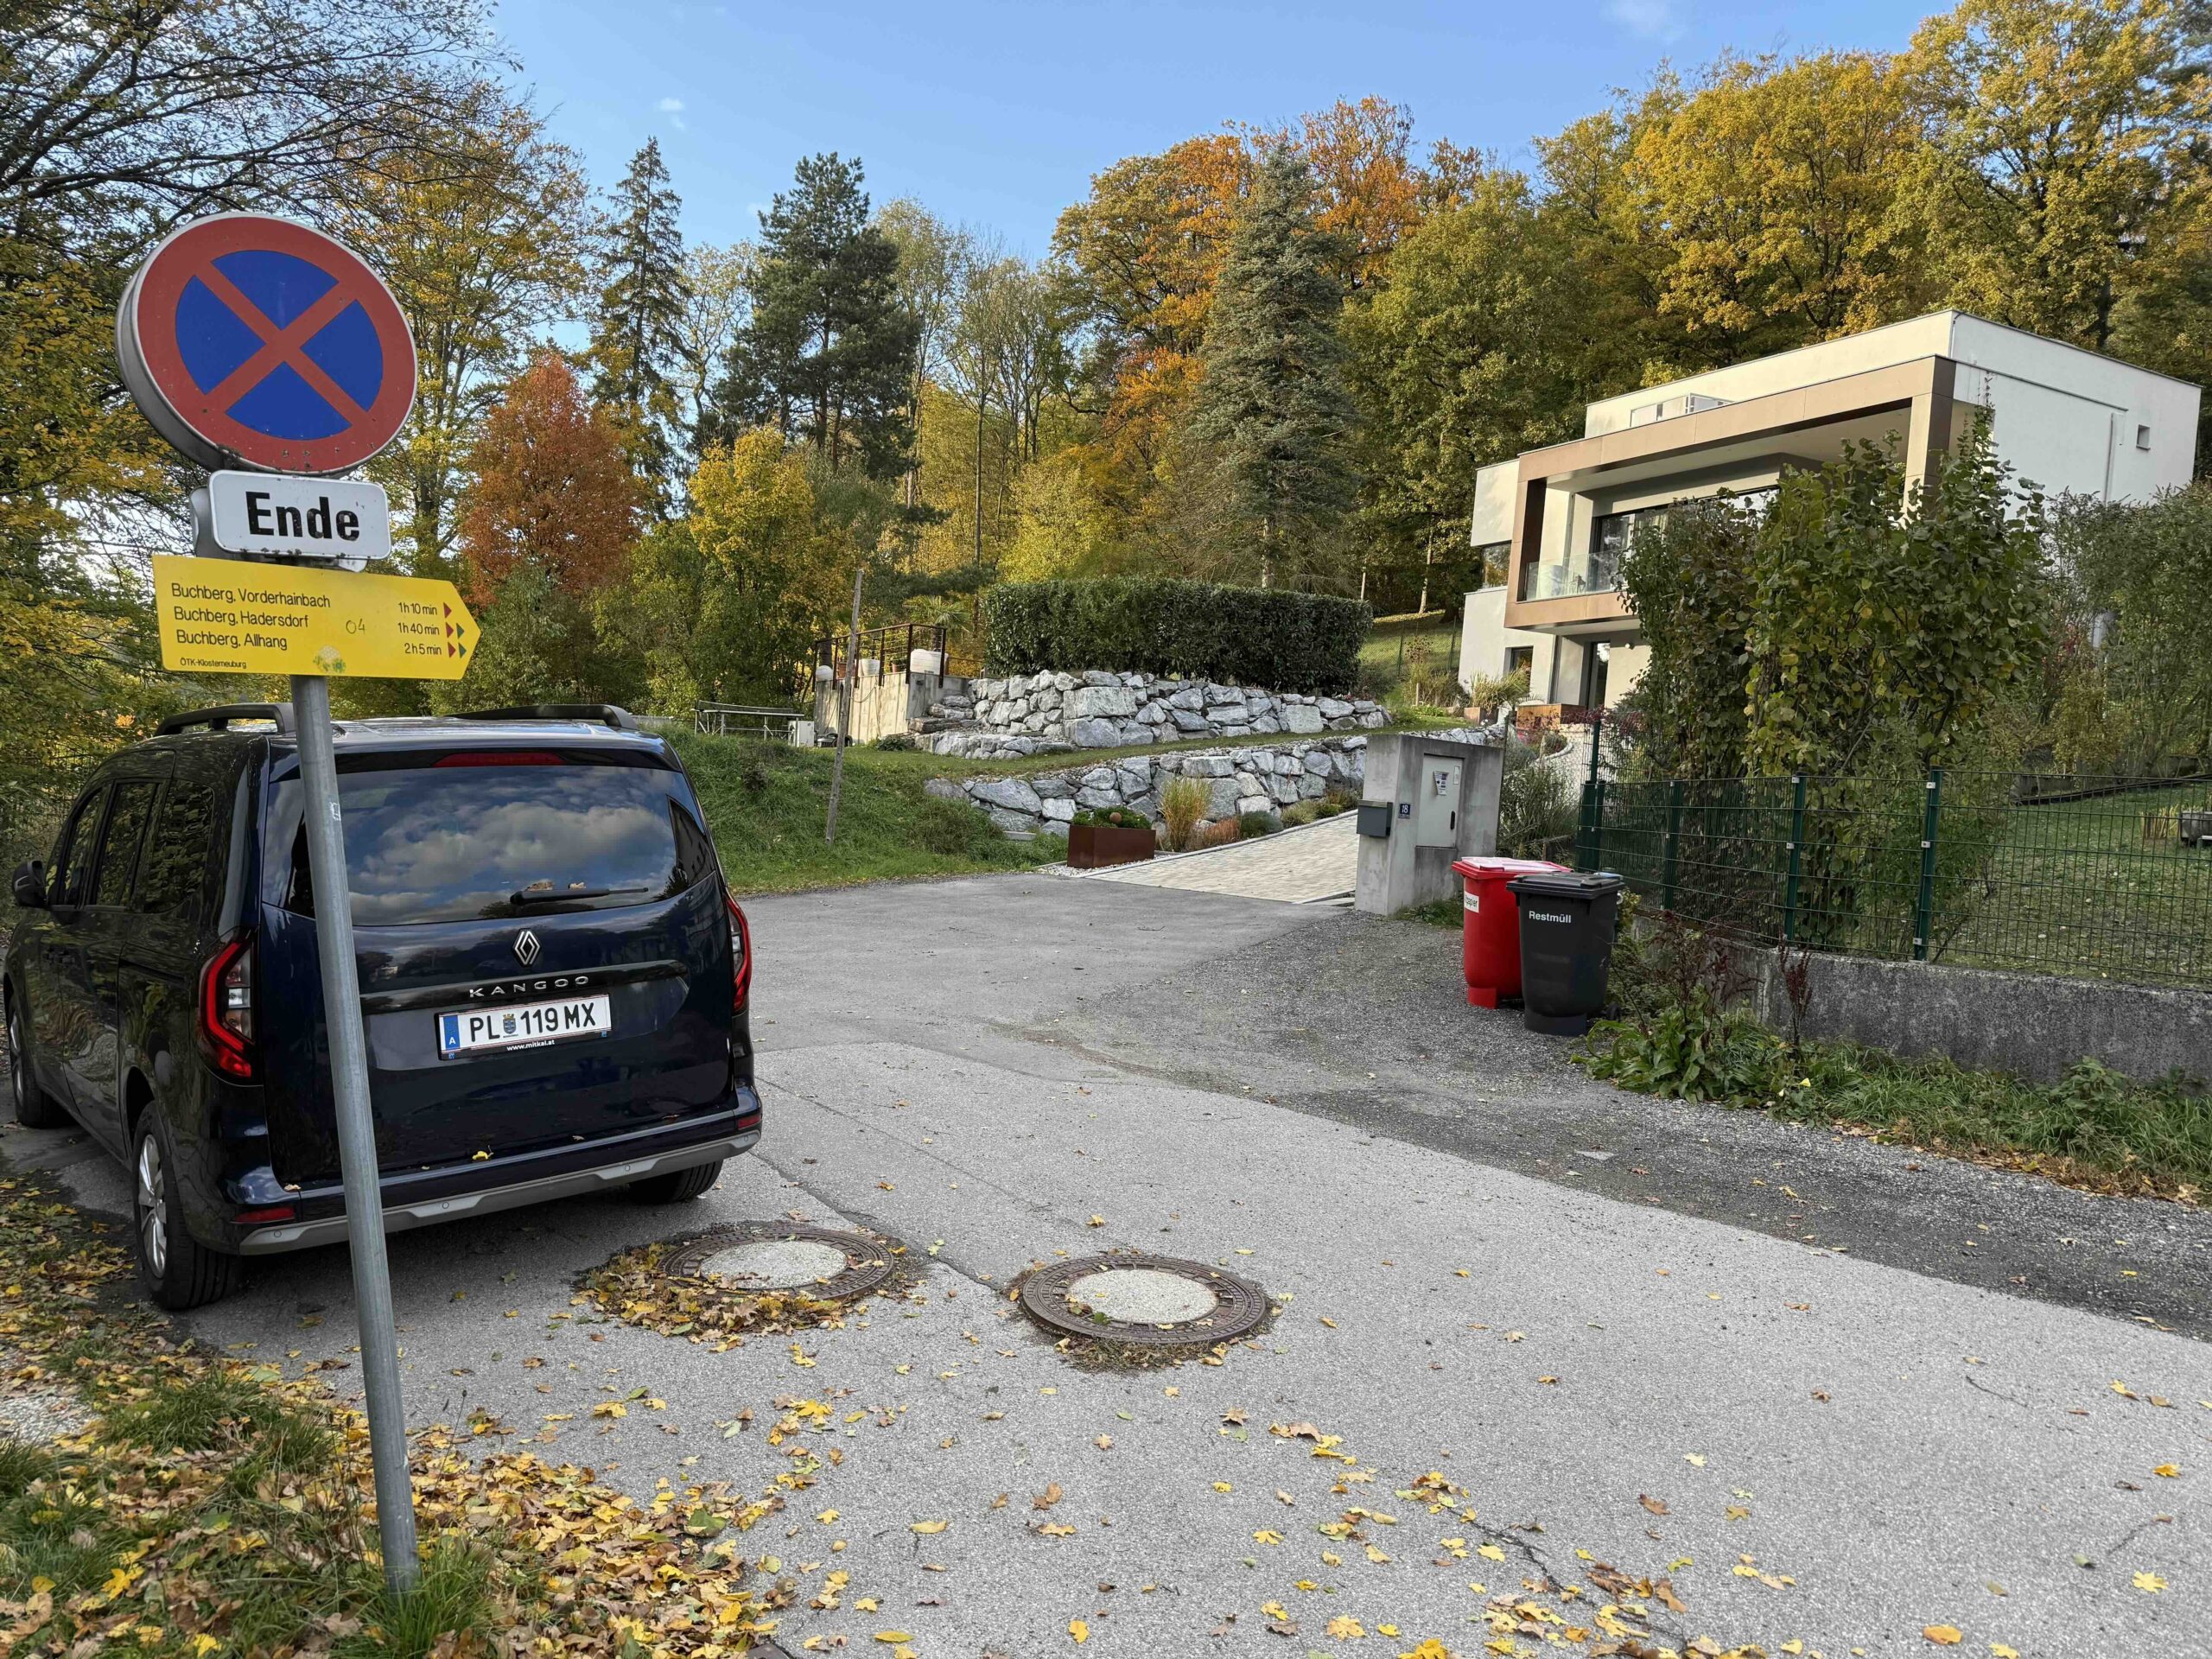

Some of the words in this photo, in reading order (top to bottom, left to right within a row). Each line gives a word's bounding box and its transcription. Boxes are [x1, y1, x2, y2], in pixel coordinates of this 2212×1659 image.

[245, 490, 360, 542] Ende
[238, 588, 331, 608] Vorderhainbach
[240, 610, 309, 628] Hadersdorf
[244, 632, 288, 651] Allhang
[1529, 910, 1572, 924] Restmüll
[469, 975, 589, 998] KANGOO
[469, 1014, 500, 1042] PL
[520, 1007, 559, 1035] 119
[563, 1001, 596, 1029] MX
[448, 1036, 456, 1046] A
